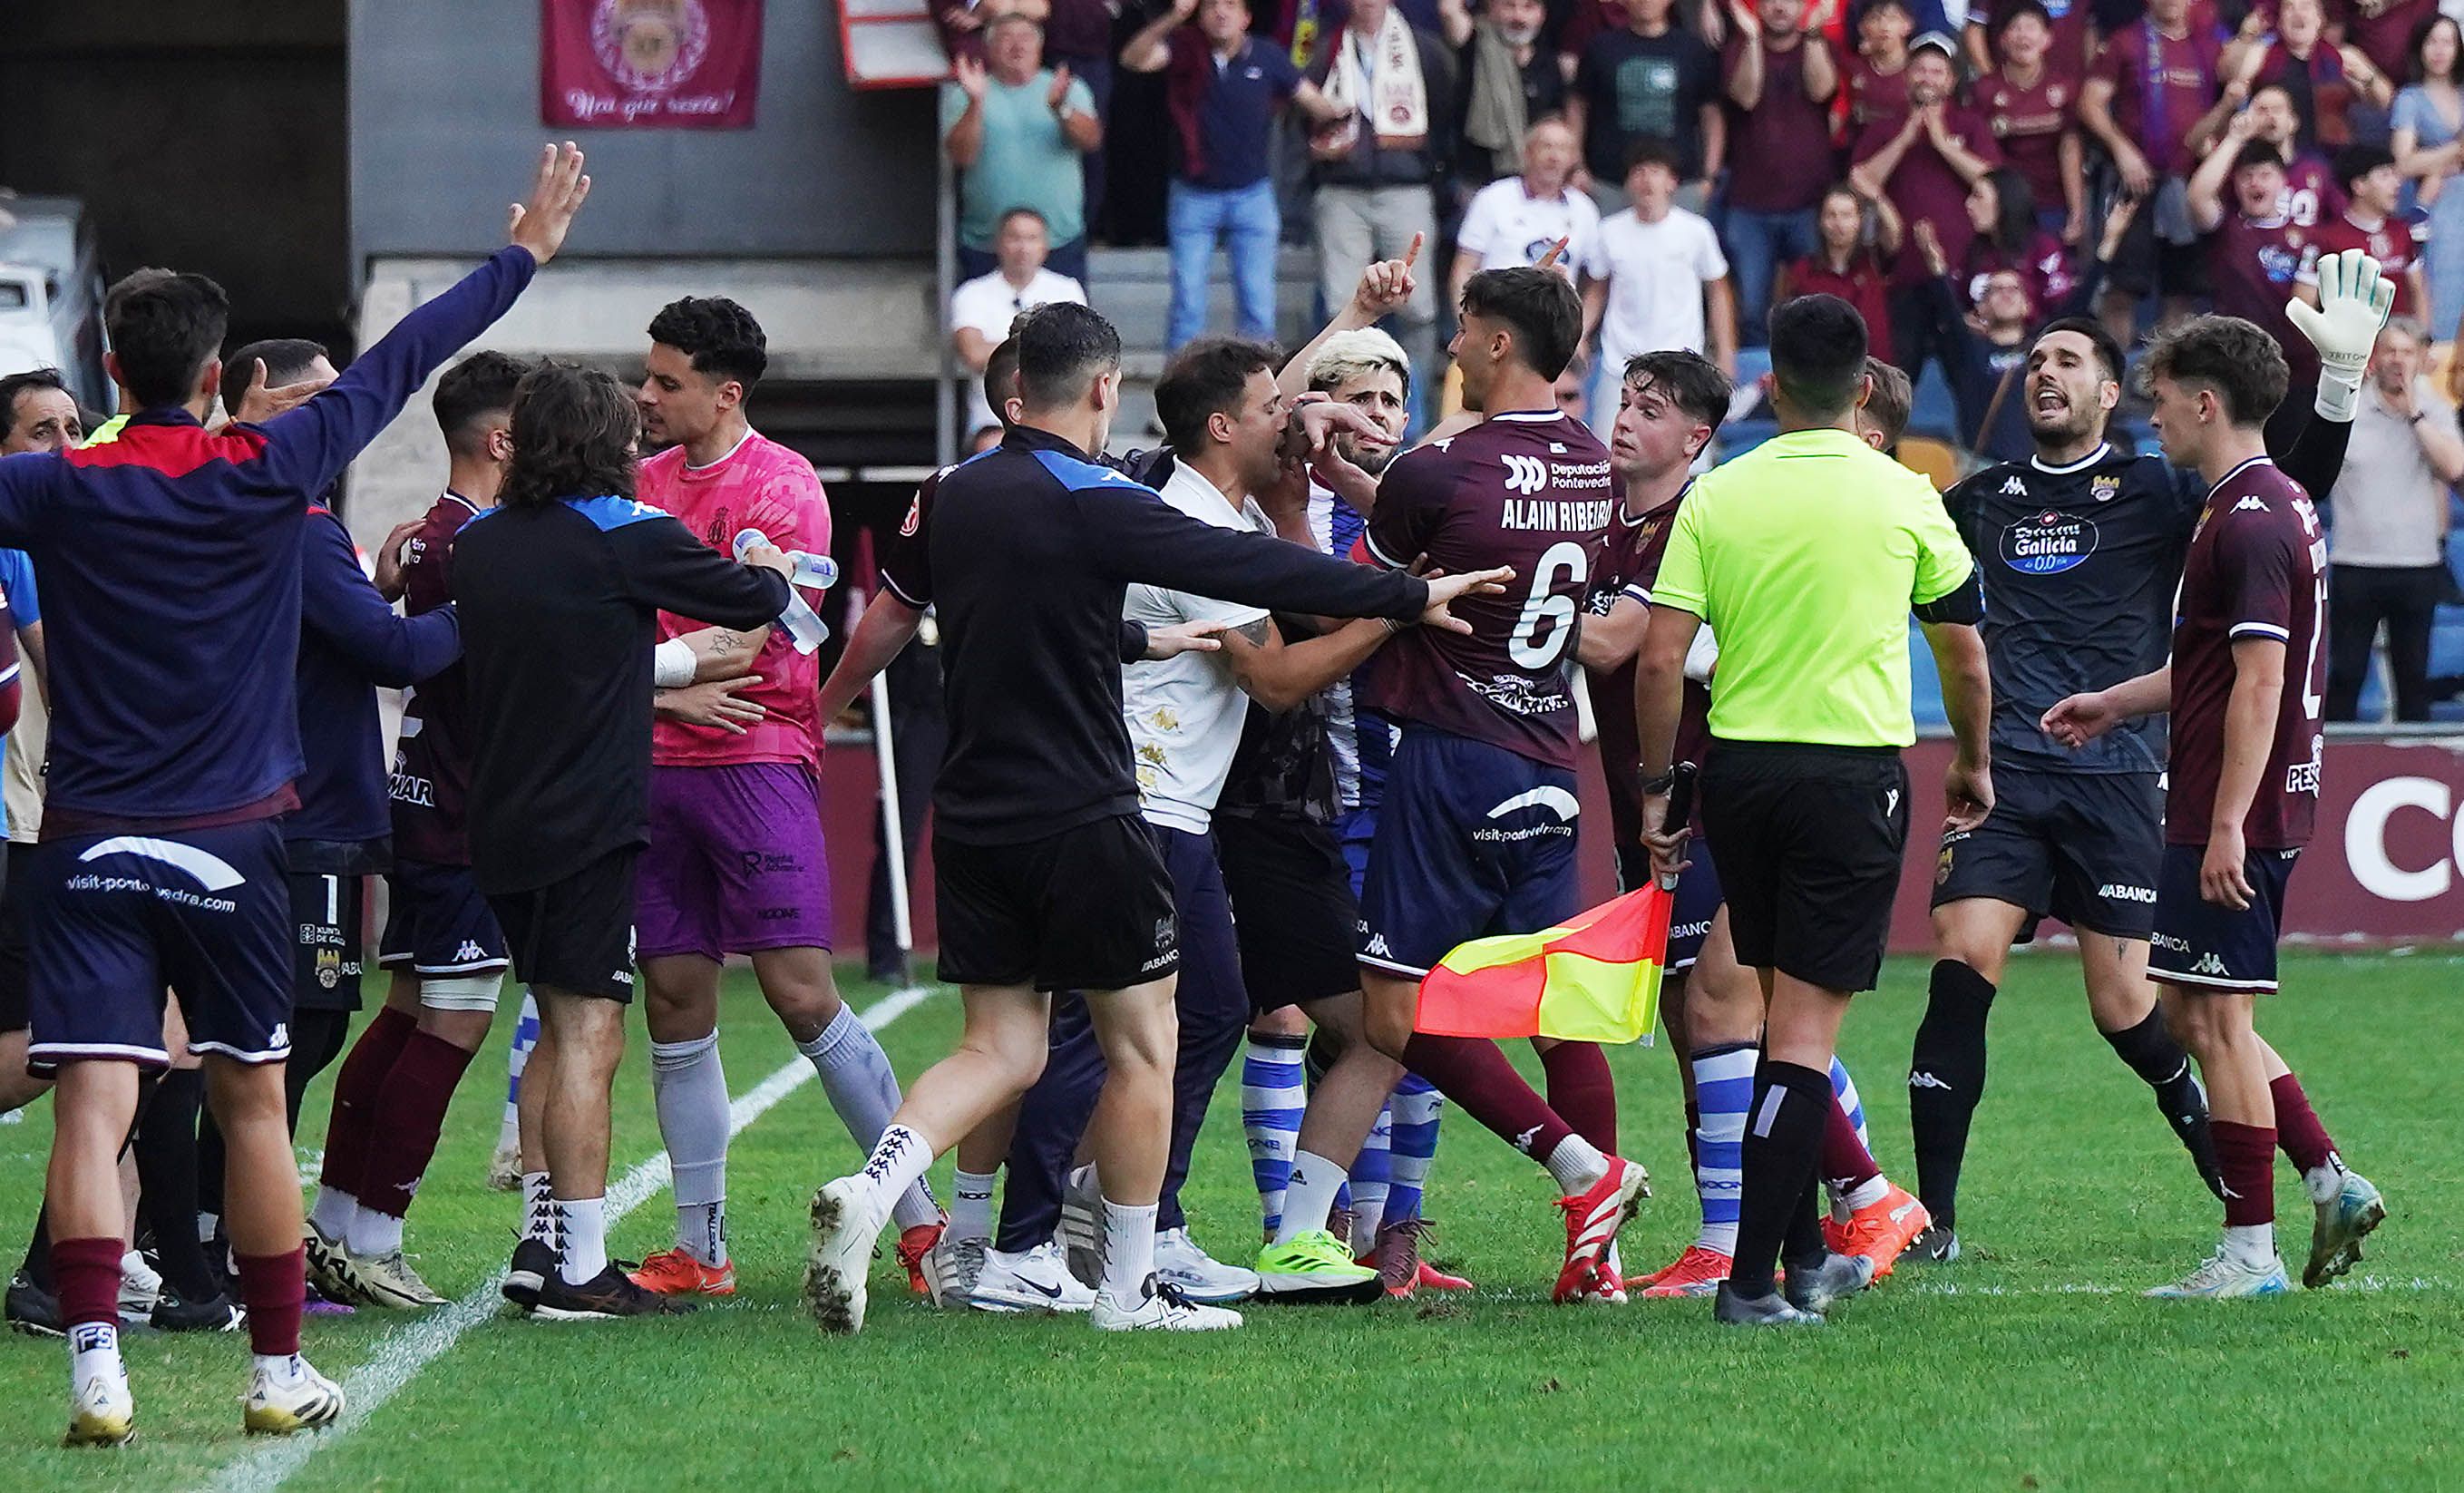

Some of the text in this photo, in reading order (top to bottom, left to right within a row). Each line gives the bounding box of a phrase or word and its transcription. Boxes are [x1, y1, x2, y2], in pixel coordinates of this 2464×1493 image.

[1551, 460, 1611, 479] Deputació
[1501, 499, 1612, 532] ALAIN RIBEIRO
[2015, 536, 2077, 556] Galicia
[1508, 542, 1587, 669] 6
[2344, 776, 2464, 902] C
[321, 873, 338, 925] 1
[2102, 883, 2157, 903] ABANCA
[2150, 931, 2192, 954] BANCA
[1141, 949, 1180, 972] ABANC
